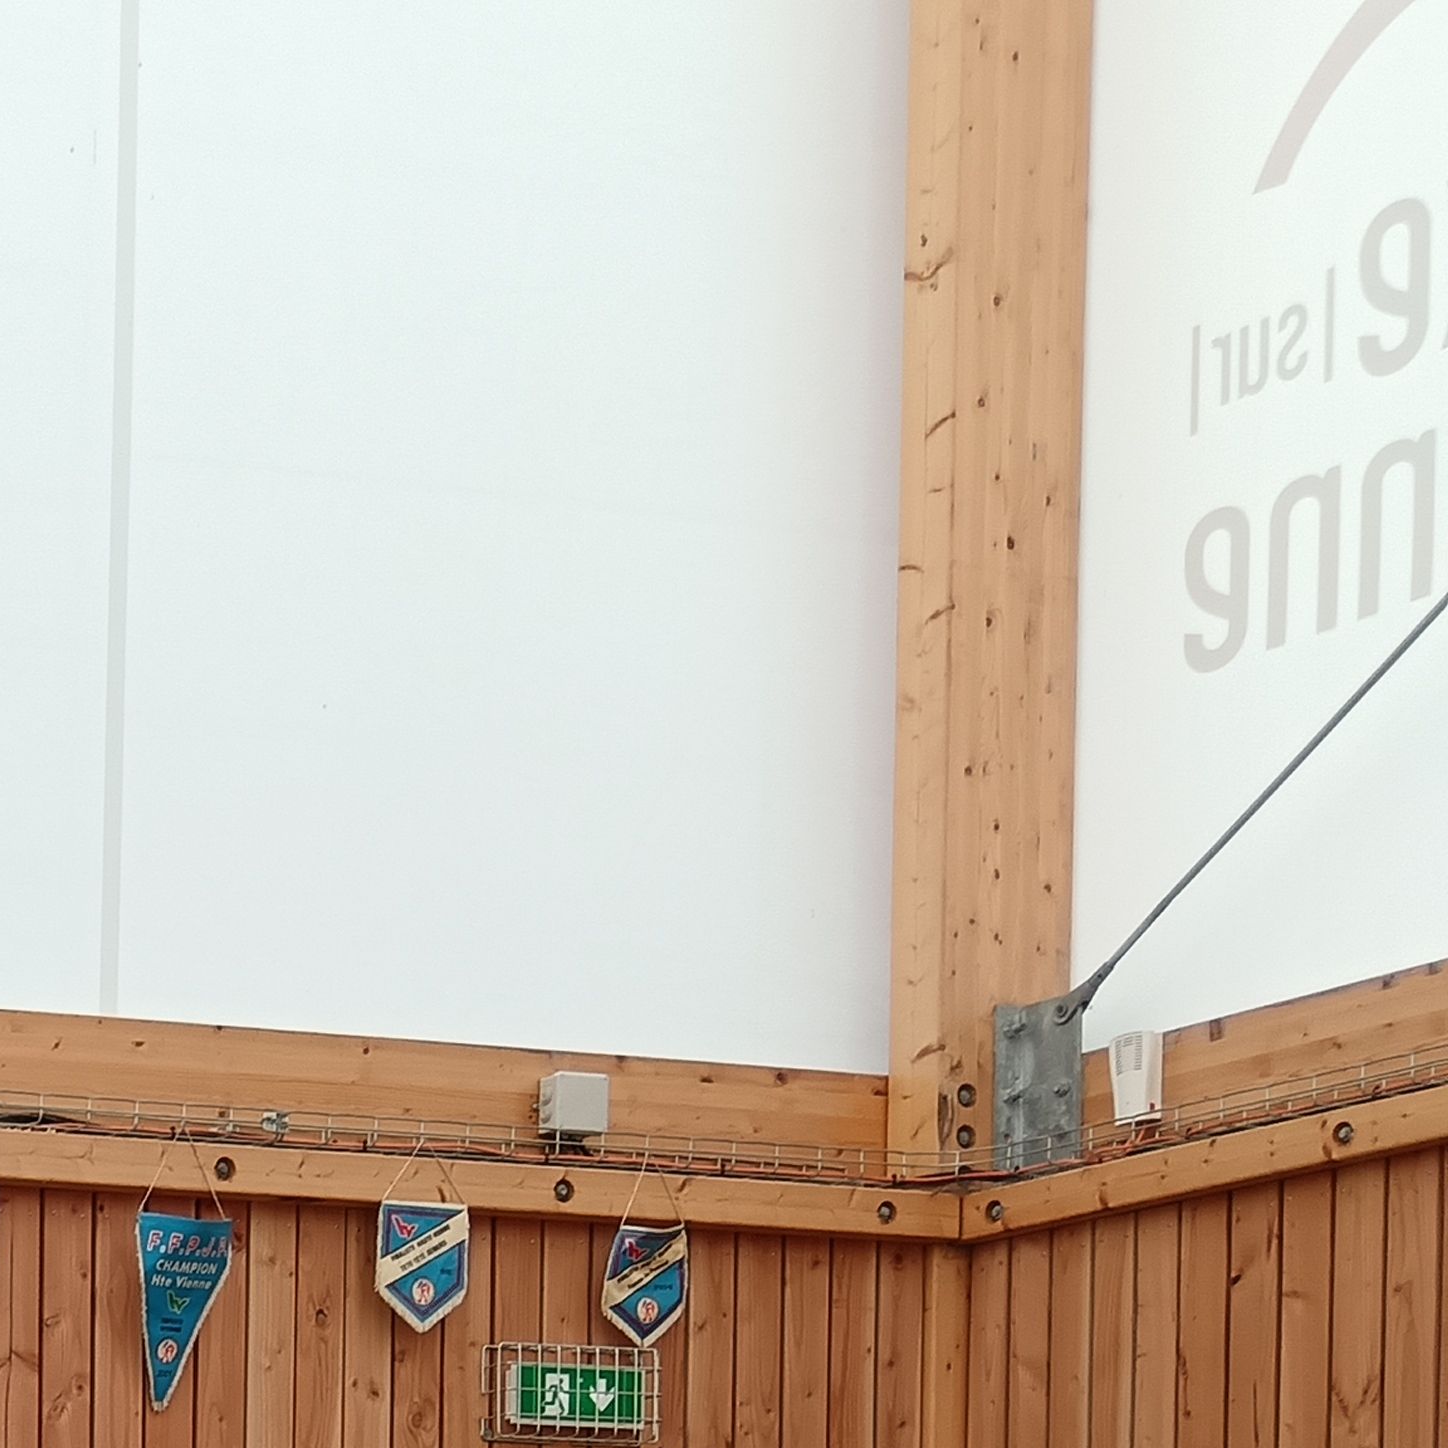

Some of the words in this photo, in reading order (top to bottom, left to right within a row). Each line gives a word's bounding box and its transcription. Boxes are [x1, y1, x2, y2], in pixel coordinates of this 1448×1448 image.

[156, 1259, 217, 1275] CHAMPION
[151, 1275, 172, 1287] Hte
[176, 1276, 212, 1289] Vienne
